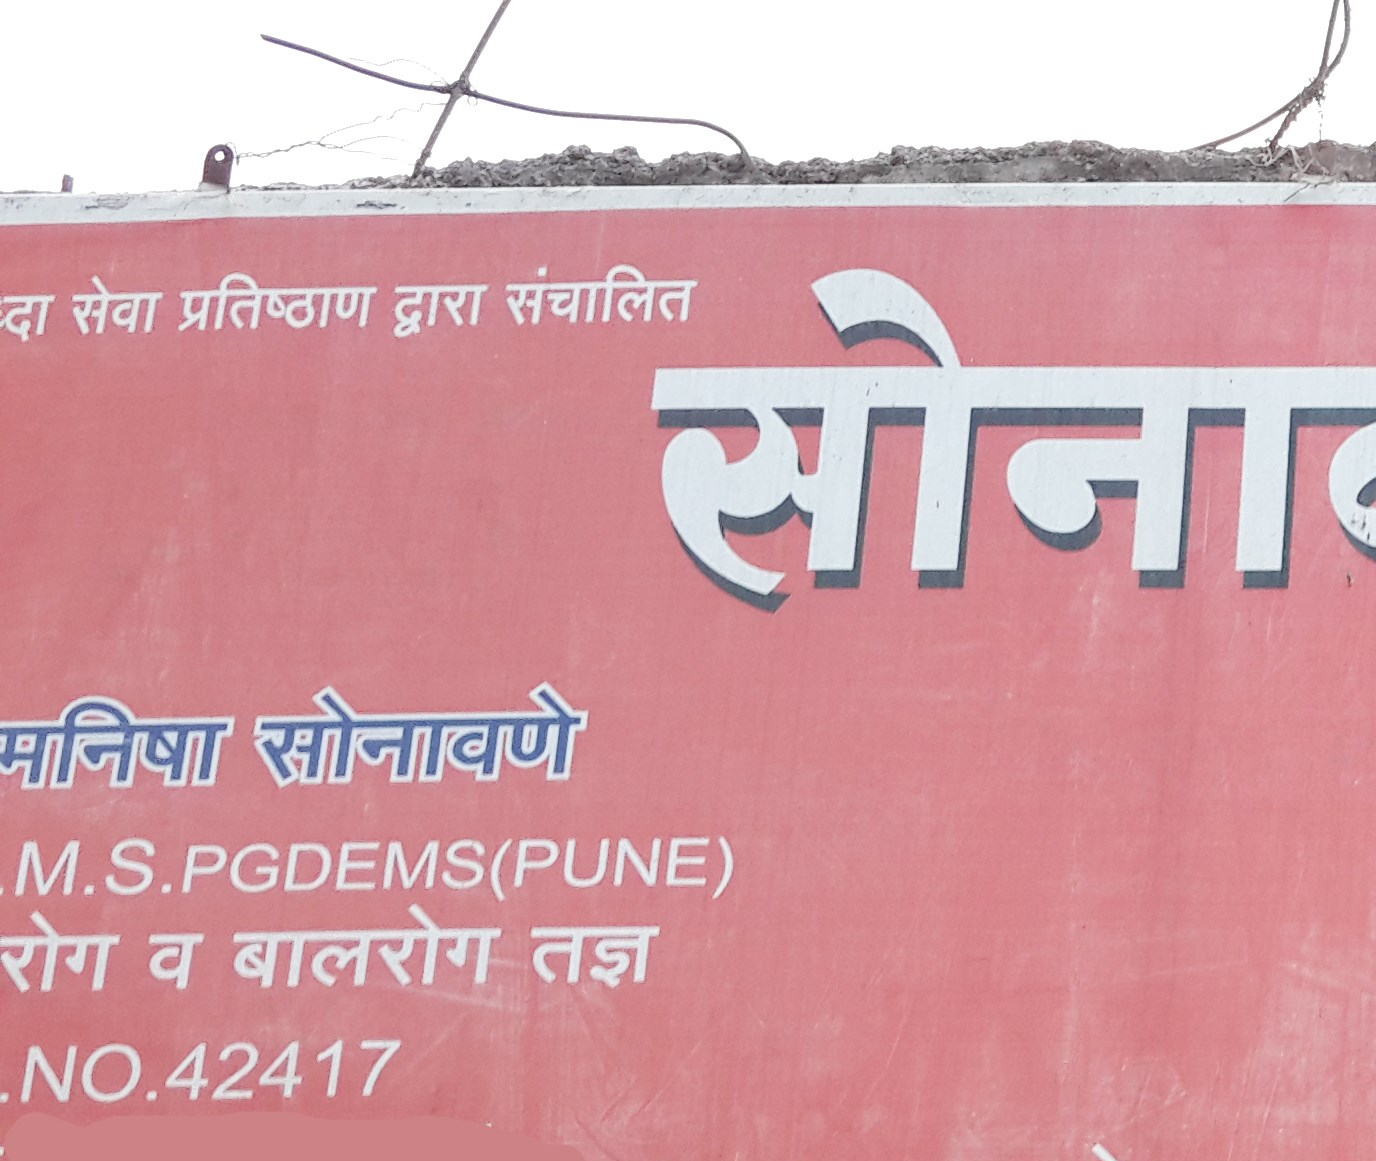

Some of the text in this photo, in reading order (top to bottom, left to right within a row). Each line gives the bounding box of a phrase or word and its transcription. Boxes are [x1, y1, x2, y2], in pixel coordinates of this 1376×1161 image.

[72, 275, 163, 335] सेवा
[178, 272, 378, 332] प्रतिष्ठाण
[393, 284, 489, 339] द्वारा
[506, 264, 698, 325] संचालित
[254, 682, 588, 788] सोनावणे
[148, 933, 205, 990] व
[234, 904, 502, 988] बालरोग
[531, 925, 661, 987] तज्ञ
